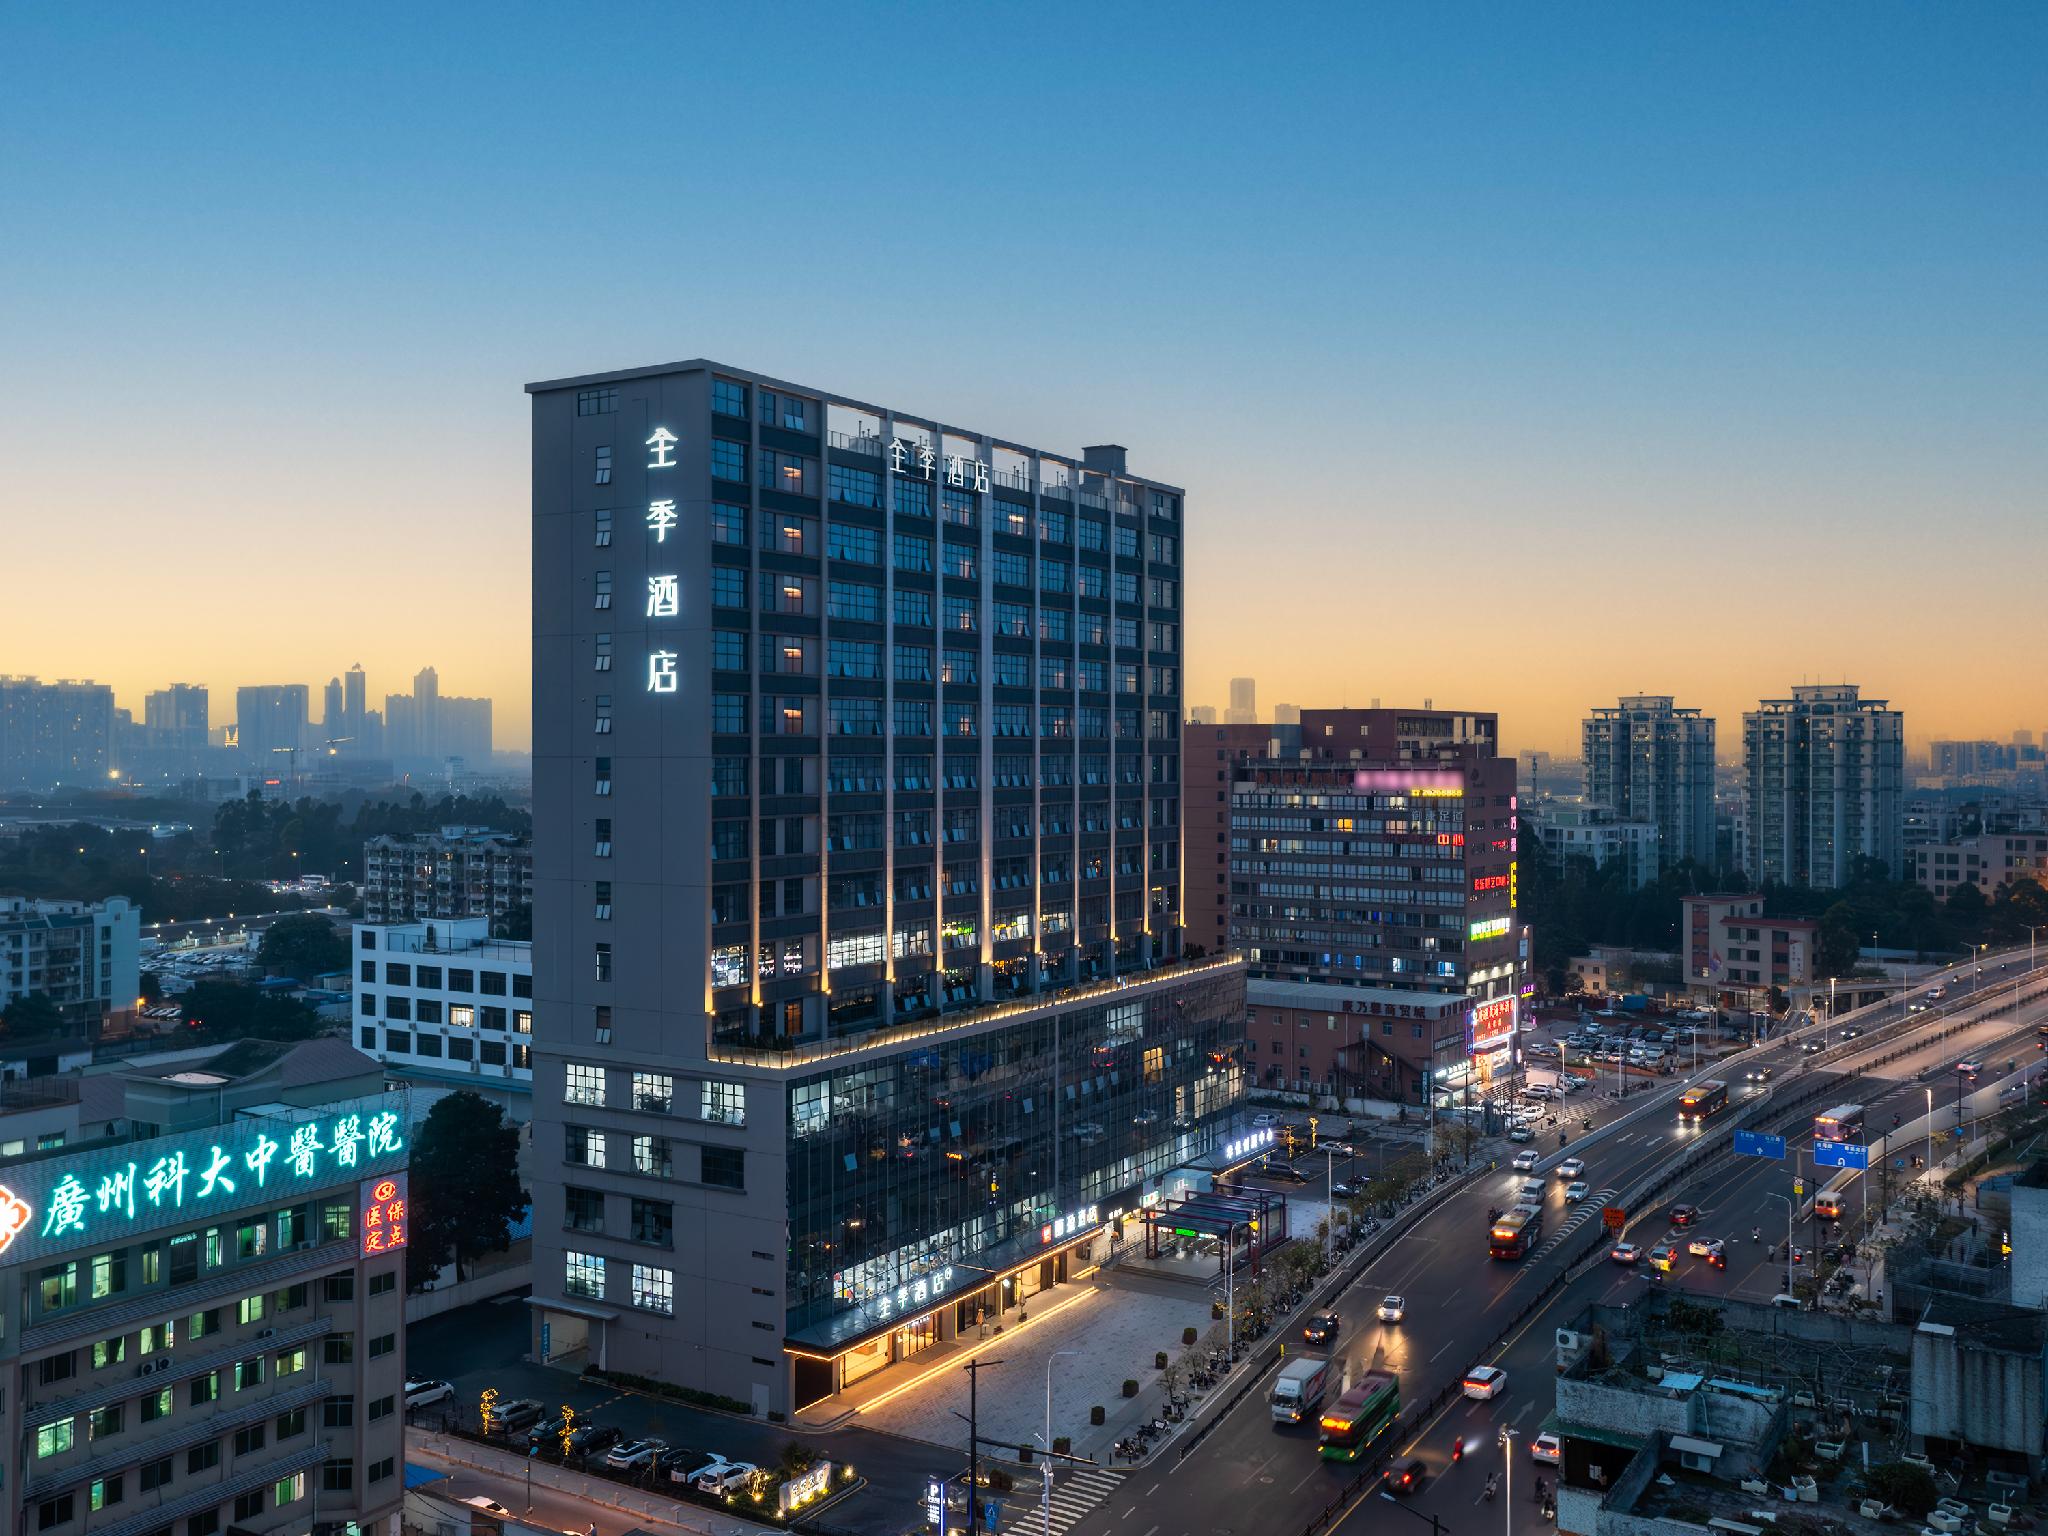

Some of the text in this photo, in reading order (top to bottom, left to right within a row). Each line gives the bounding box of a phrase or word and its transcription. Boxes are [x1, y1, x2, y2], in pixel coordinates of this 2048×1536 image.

[888, 437, 990, 494] 全季酒店
[645, 427, 679, 693] 全季酒店
[42, 1111, 403, 1237] 廣州科大中醫醫院
